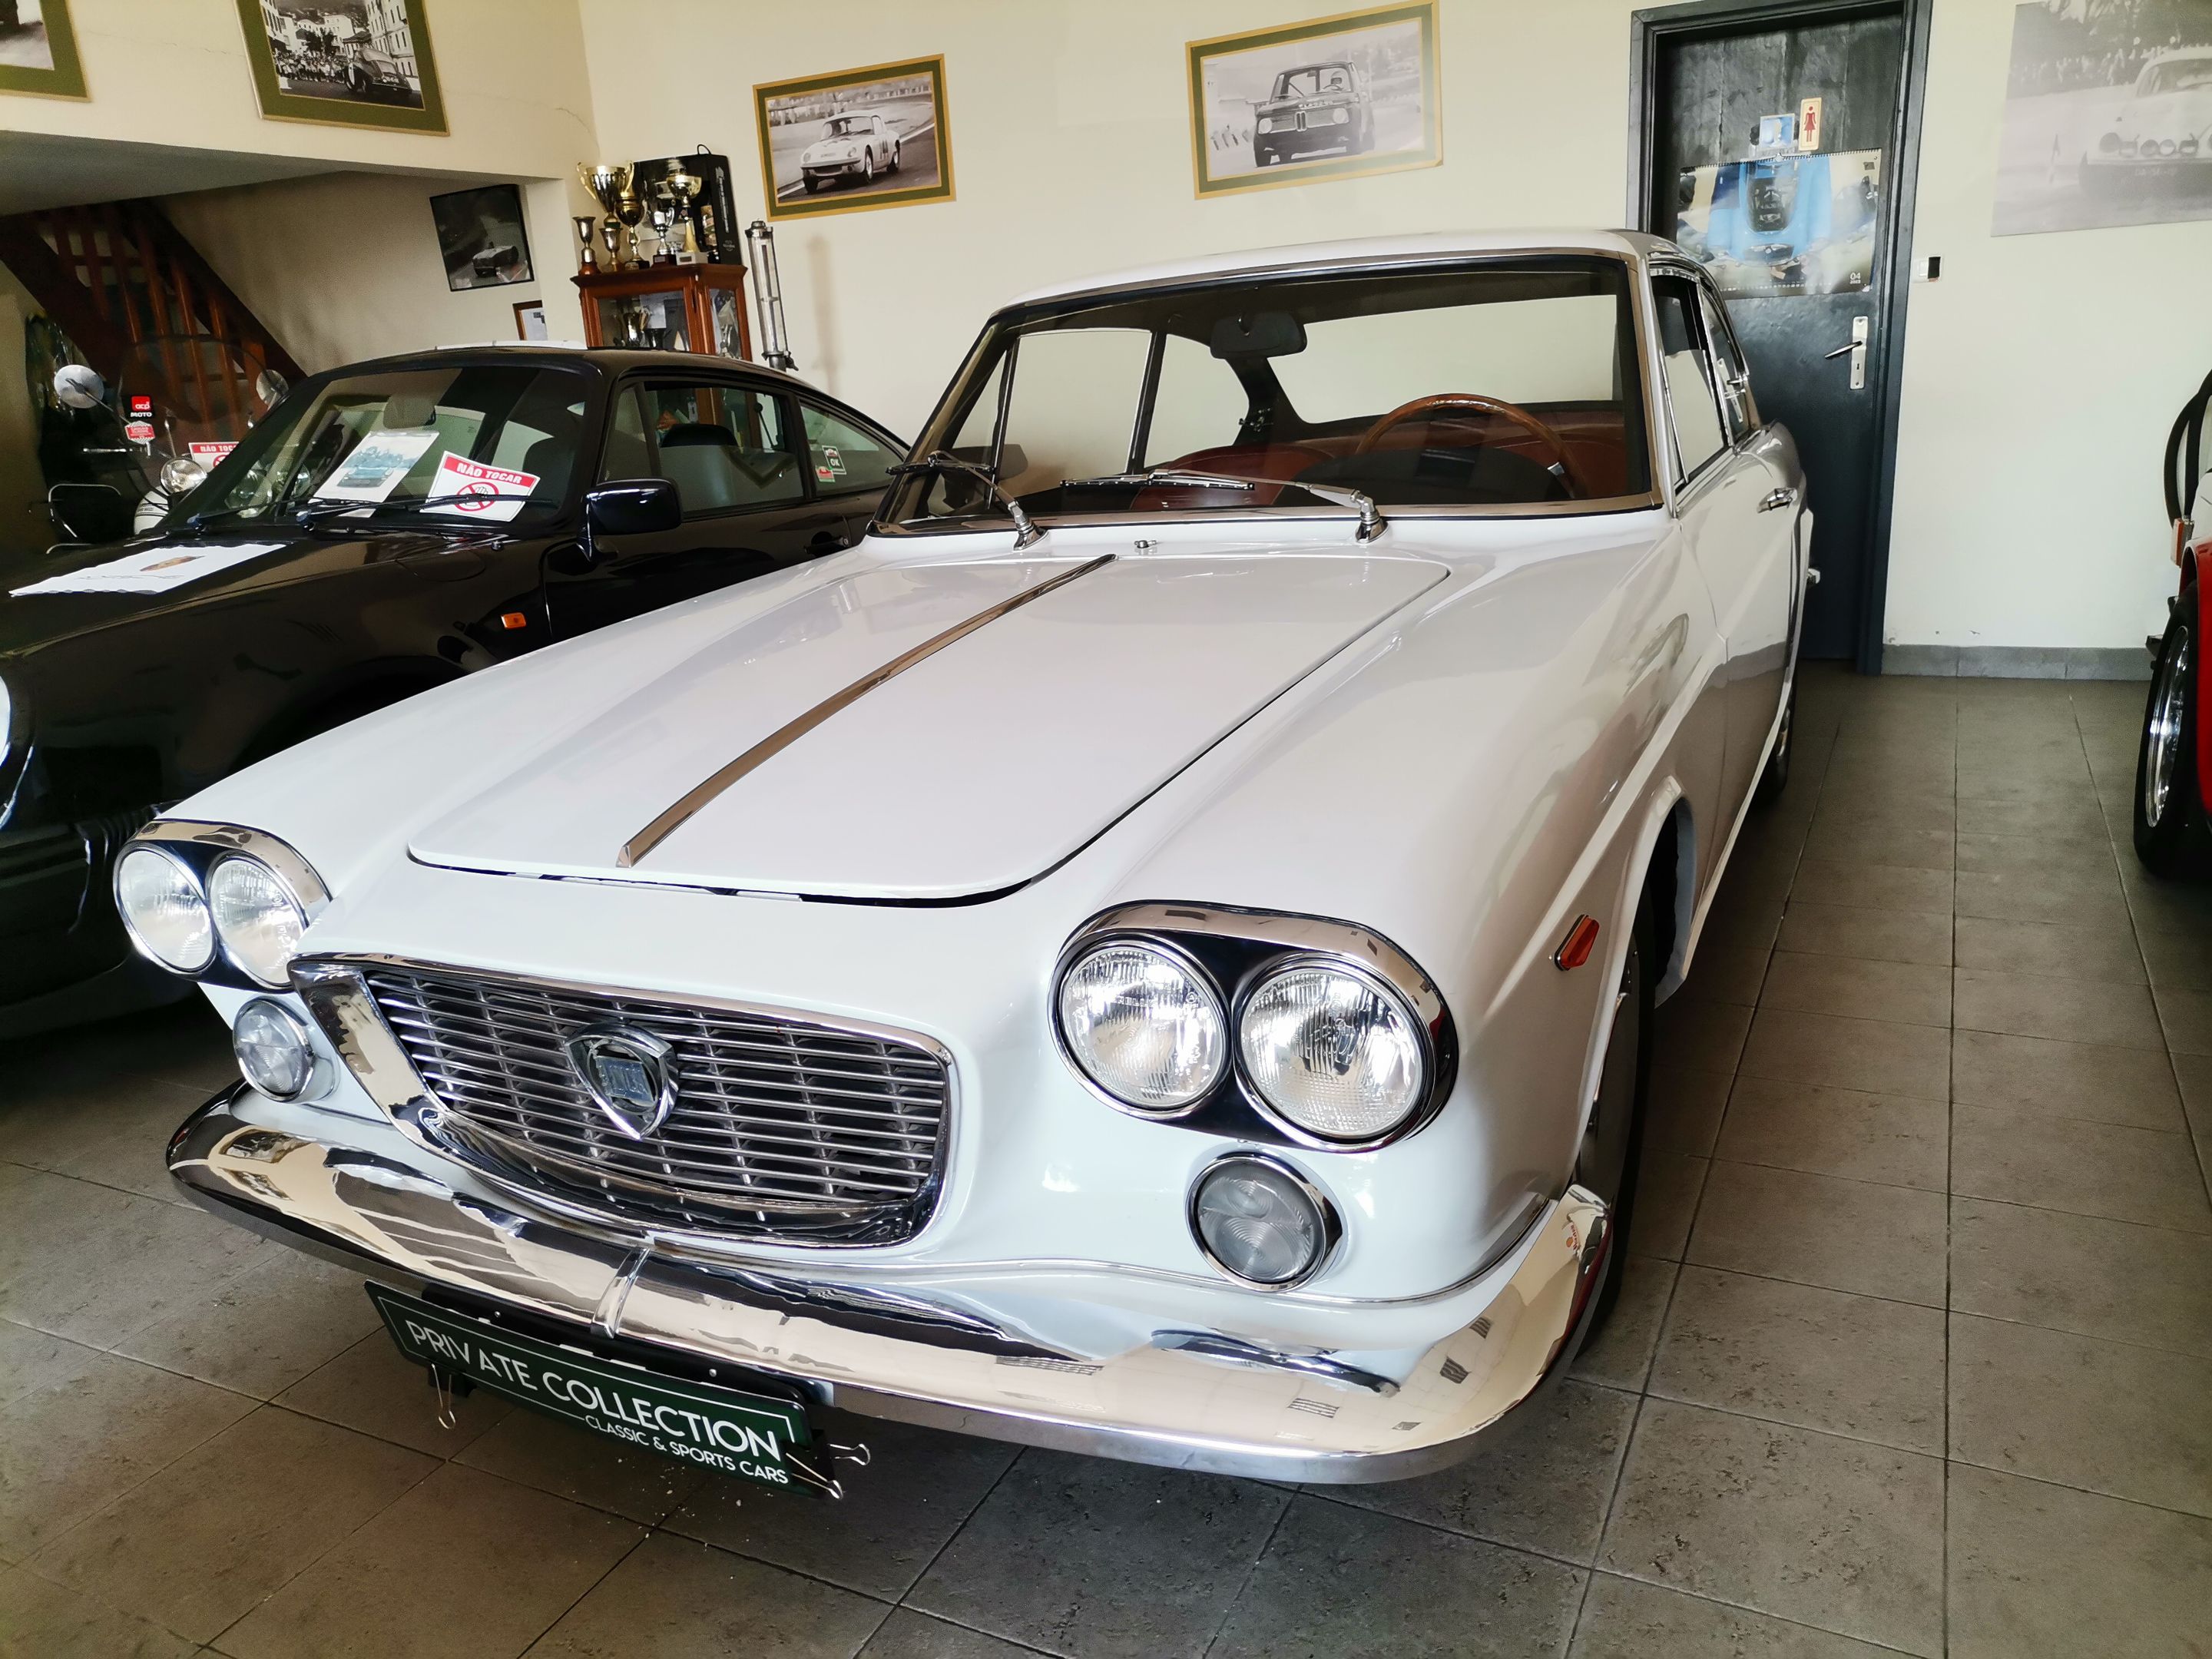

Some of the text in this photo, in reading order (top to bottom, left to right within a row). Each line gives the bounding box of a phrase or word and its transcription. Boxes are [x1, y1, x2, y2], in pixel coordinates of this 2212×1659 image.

[1849, 272, 1861, 280] 04
[456, 462, 522, 484] NÃO TOCAR
[830, 458, 841, 467] OK
[405, 1320, 781, 1462] PRIVATE COLLECTION
[584, 1415, 789, 1485] CLASSIC & SPORTS CARS
